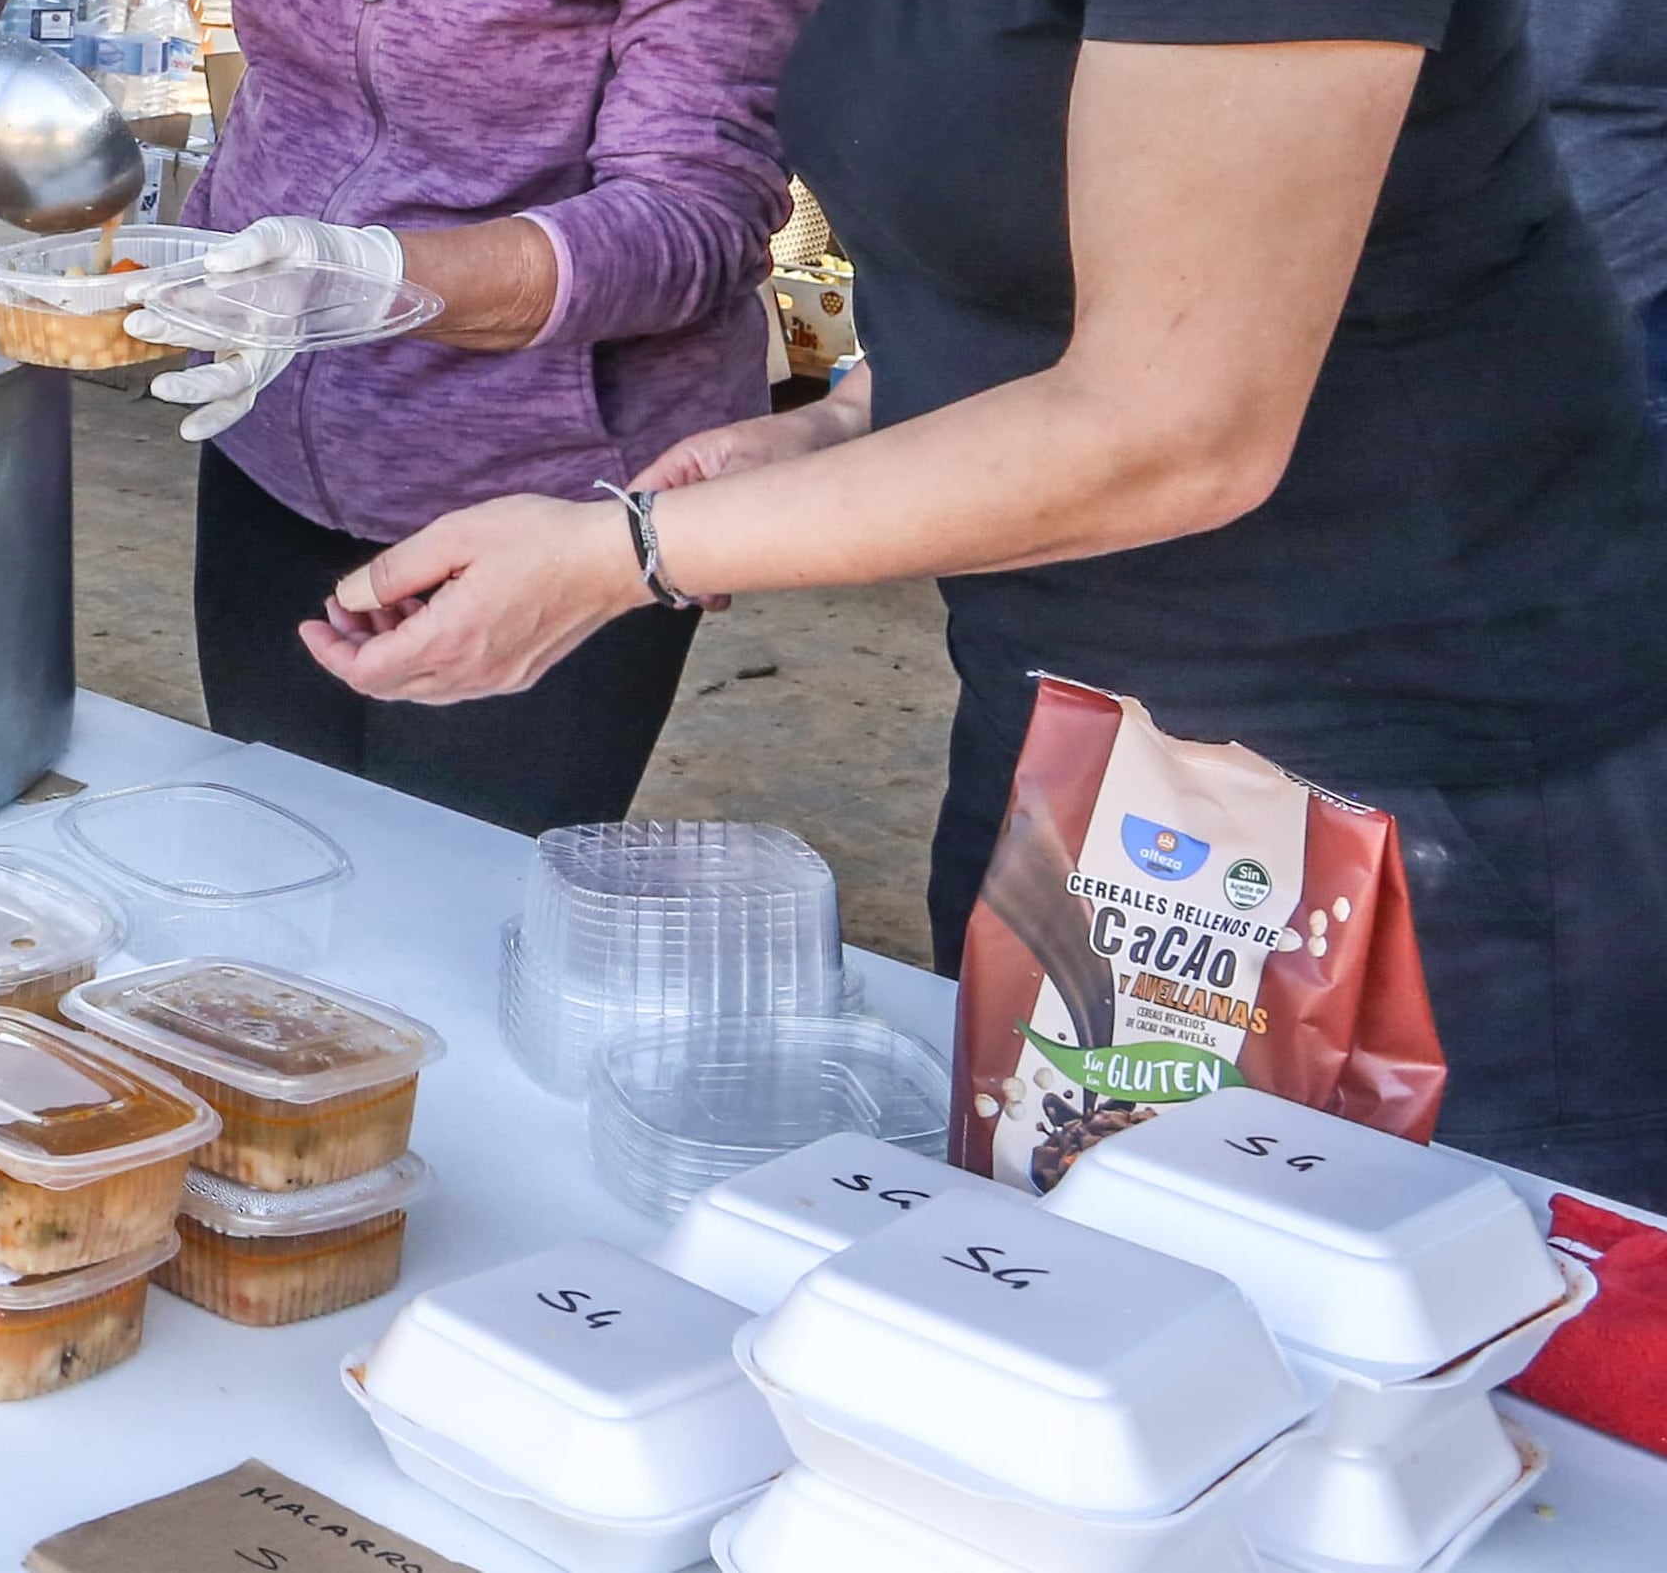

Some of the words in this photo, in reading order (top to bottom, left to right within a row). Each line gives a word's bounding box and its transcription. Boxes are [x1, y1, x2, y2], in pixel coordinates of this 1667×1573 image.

[1139, 848, 1183, 871] alteza
[1239, 866, 1260, 881] Sin
[1069, 874, 1168, 916] CEREALES
[1174, 902, 1251, 939] RELLENOS
[1253, 926, 1280, 947] DE
[1118, 974, 1133, 994] Y
[1130, 971, 1268, 1035] AVELLANAS
[1160, 1025, 1175, 1037] COM
[1165, 1012, 1207, 1031] RECHEIOS
[1083, 1050, 1104, 1073] Sin
[1106, 1053, 1222, 1094] GLUTEN
